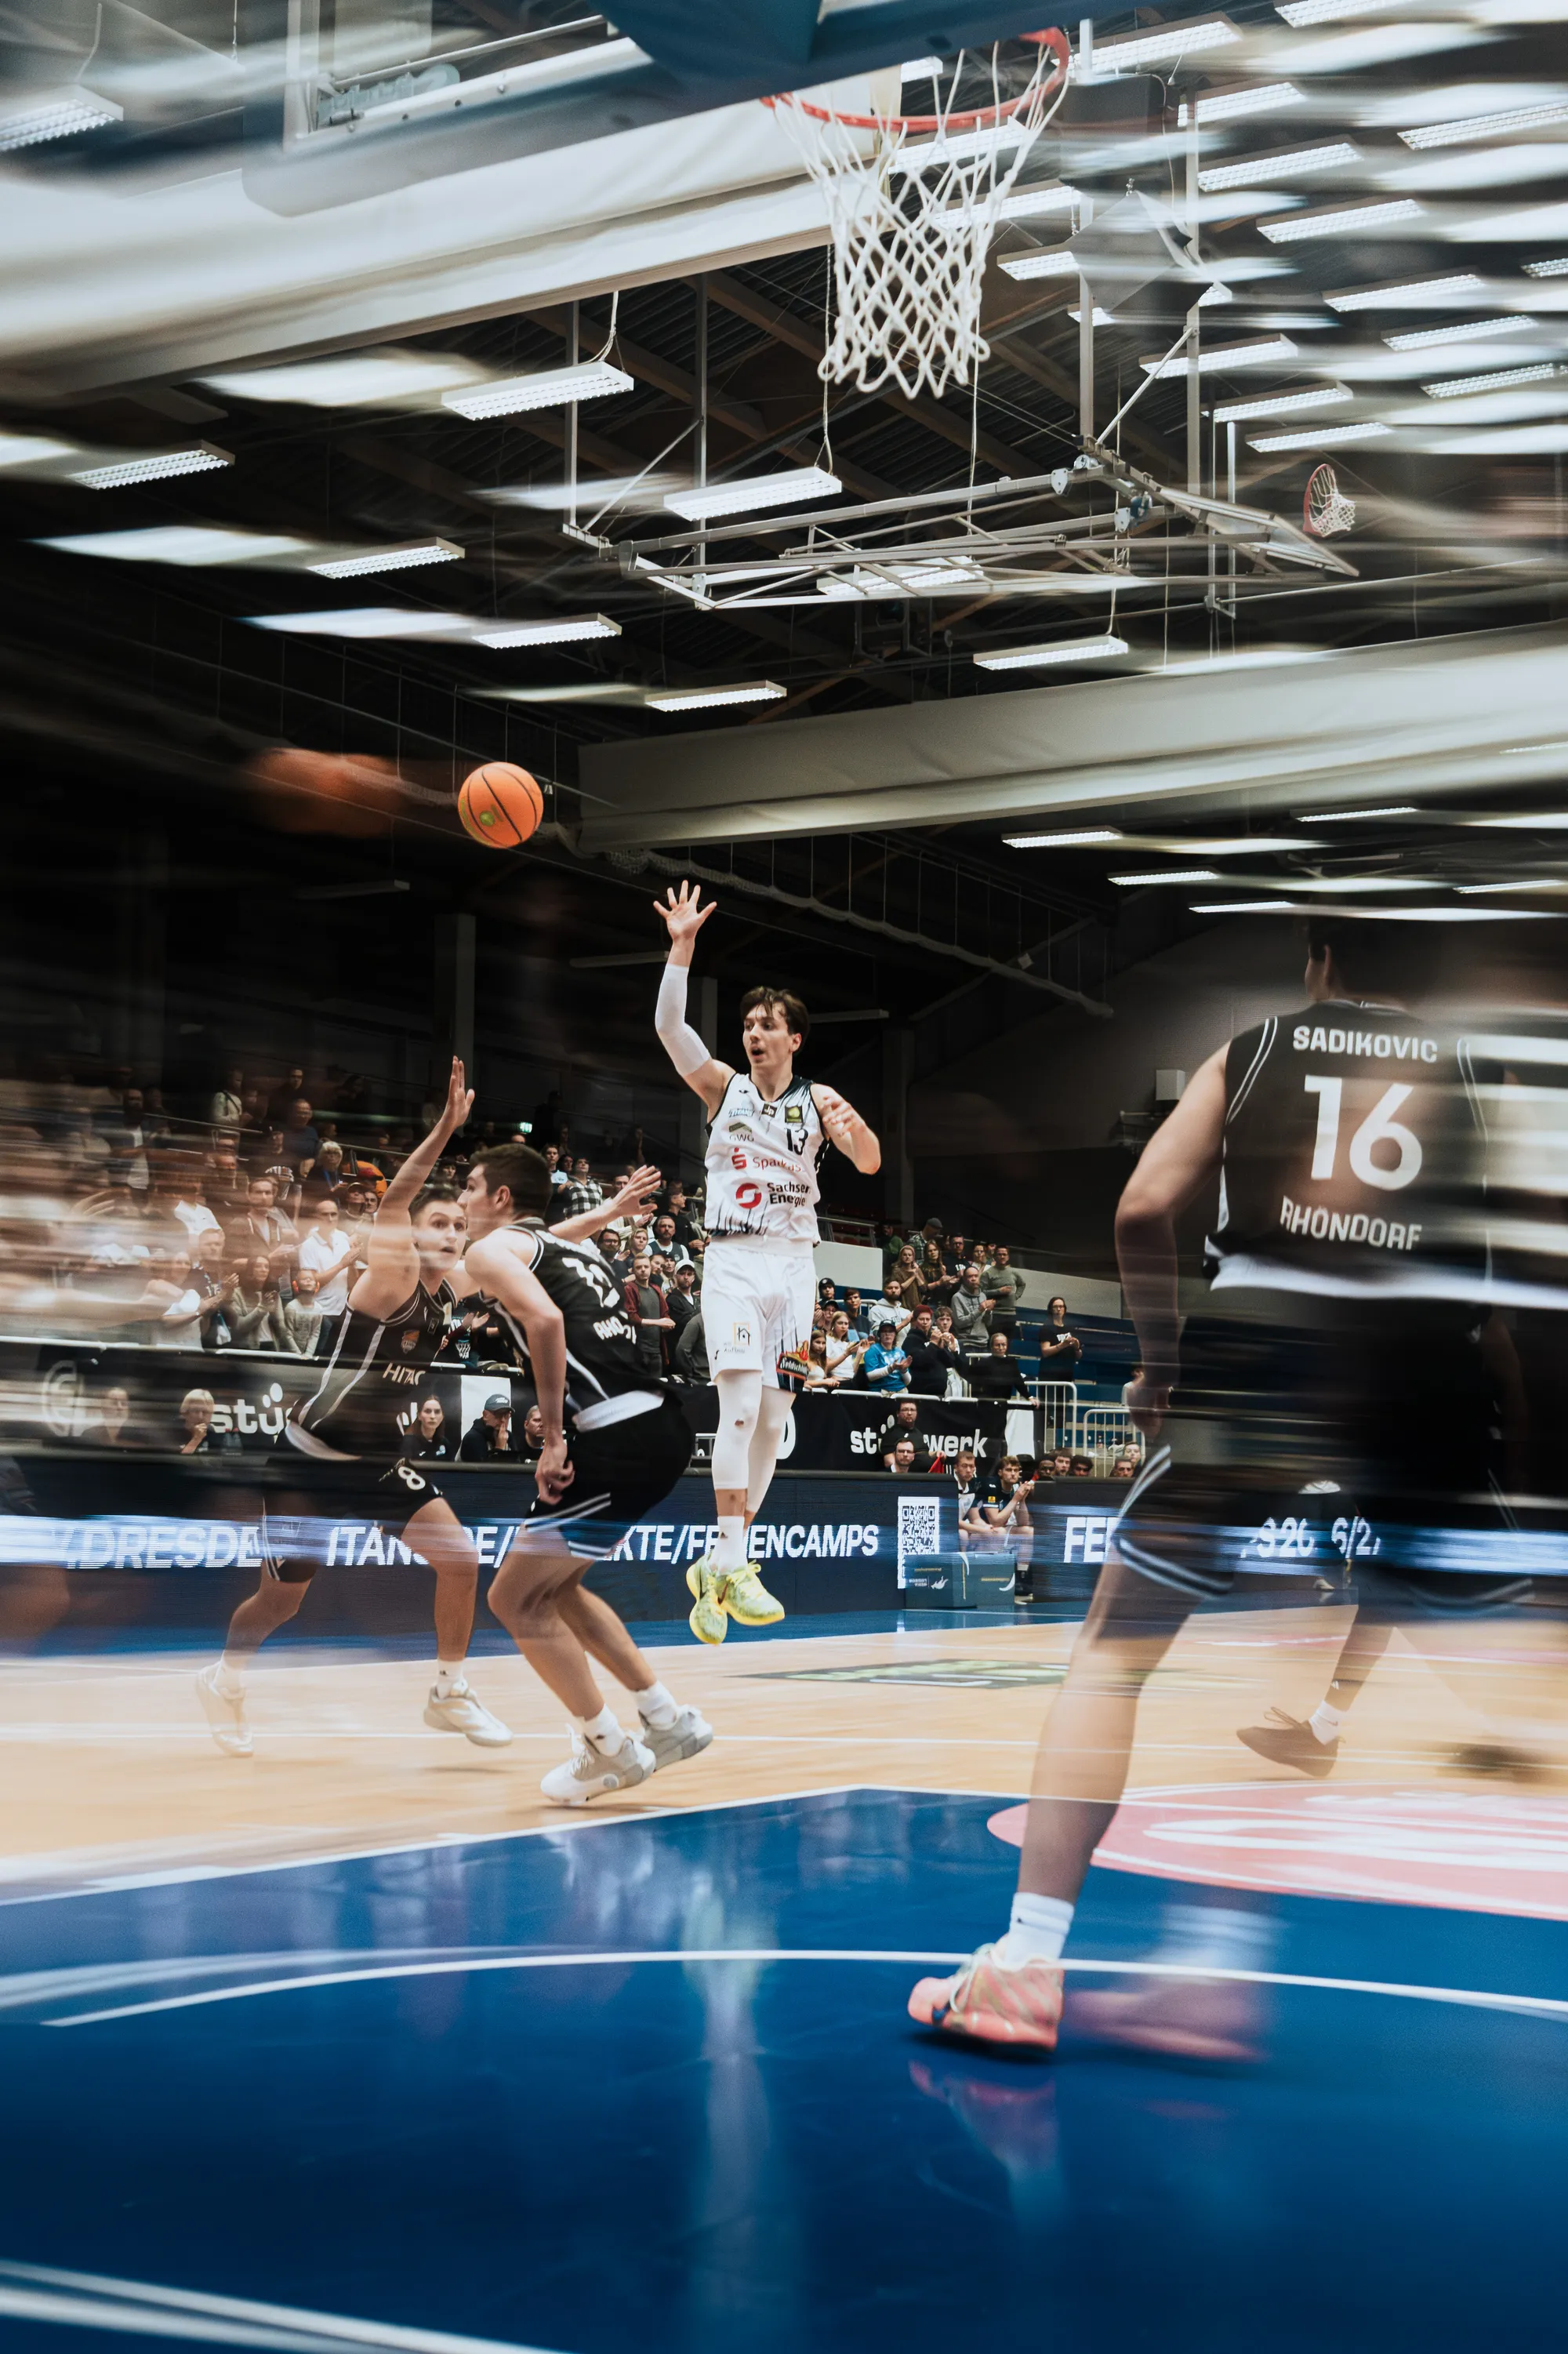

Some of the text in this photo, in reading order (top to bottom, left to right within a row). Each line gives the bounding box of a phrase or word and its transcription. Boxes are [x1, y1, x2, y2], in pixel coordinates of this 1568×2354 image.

[1292, 1025, 1439, 1063] SADIKOVIC
[784, 1128, 809, 1156] 13
[1303, 1074, 1423, 1191] 16
[1279, 1195, 1423, 1251] RHÖNDORF
[397, 1466, 426, 1491] 8
